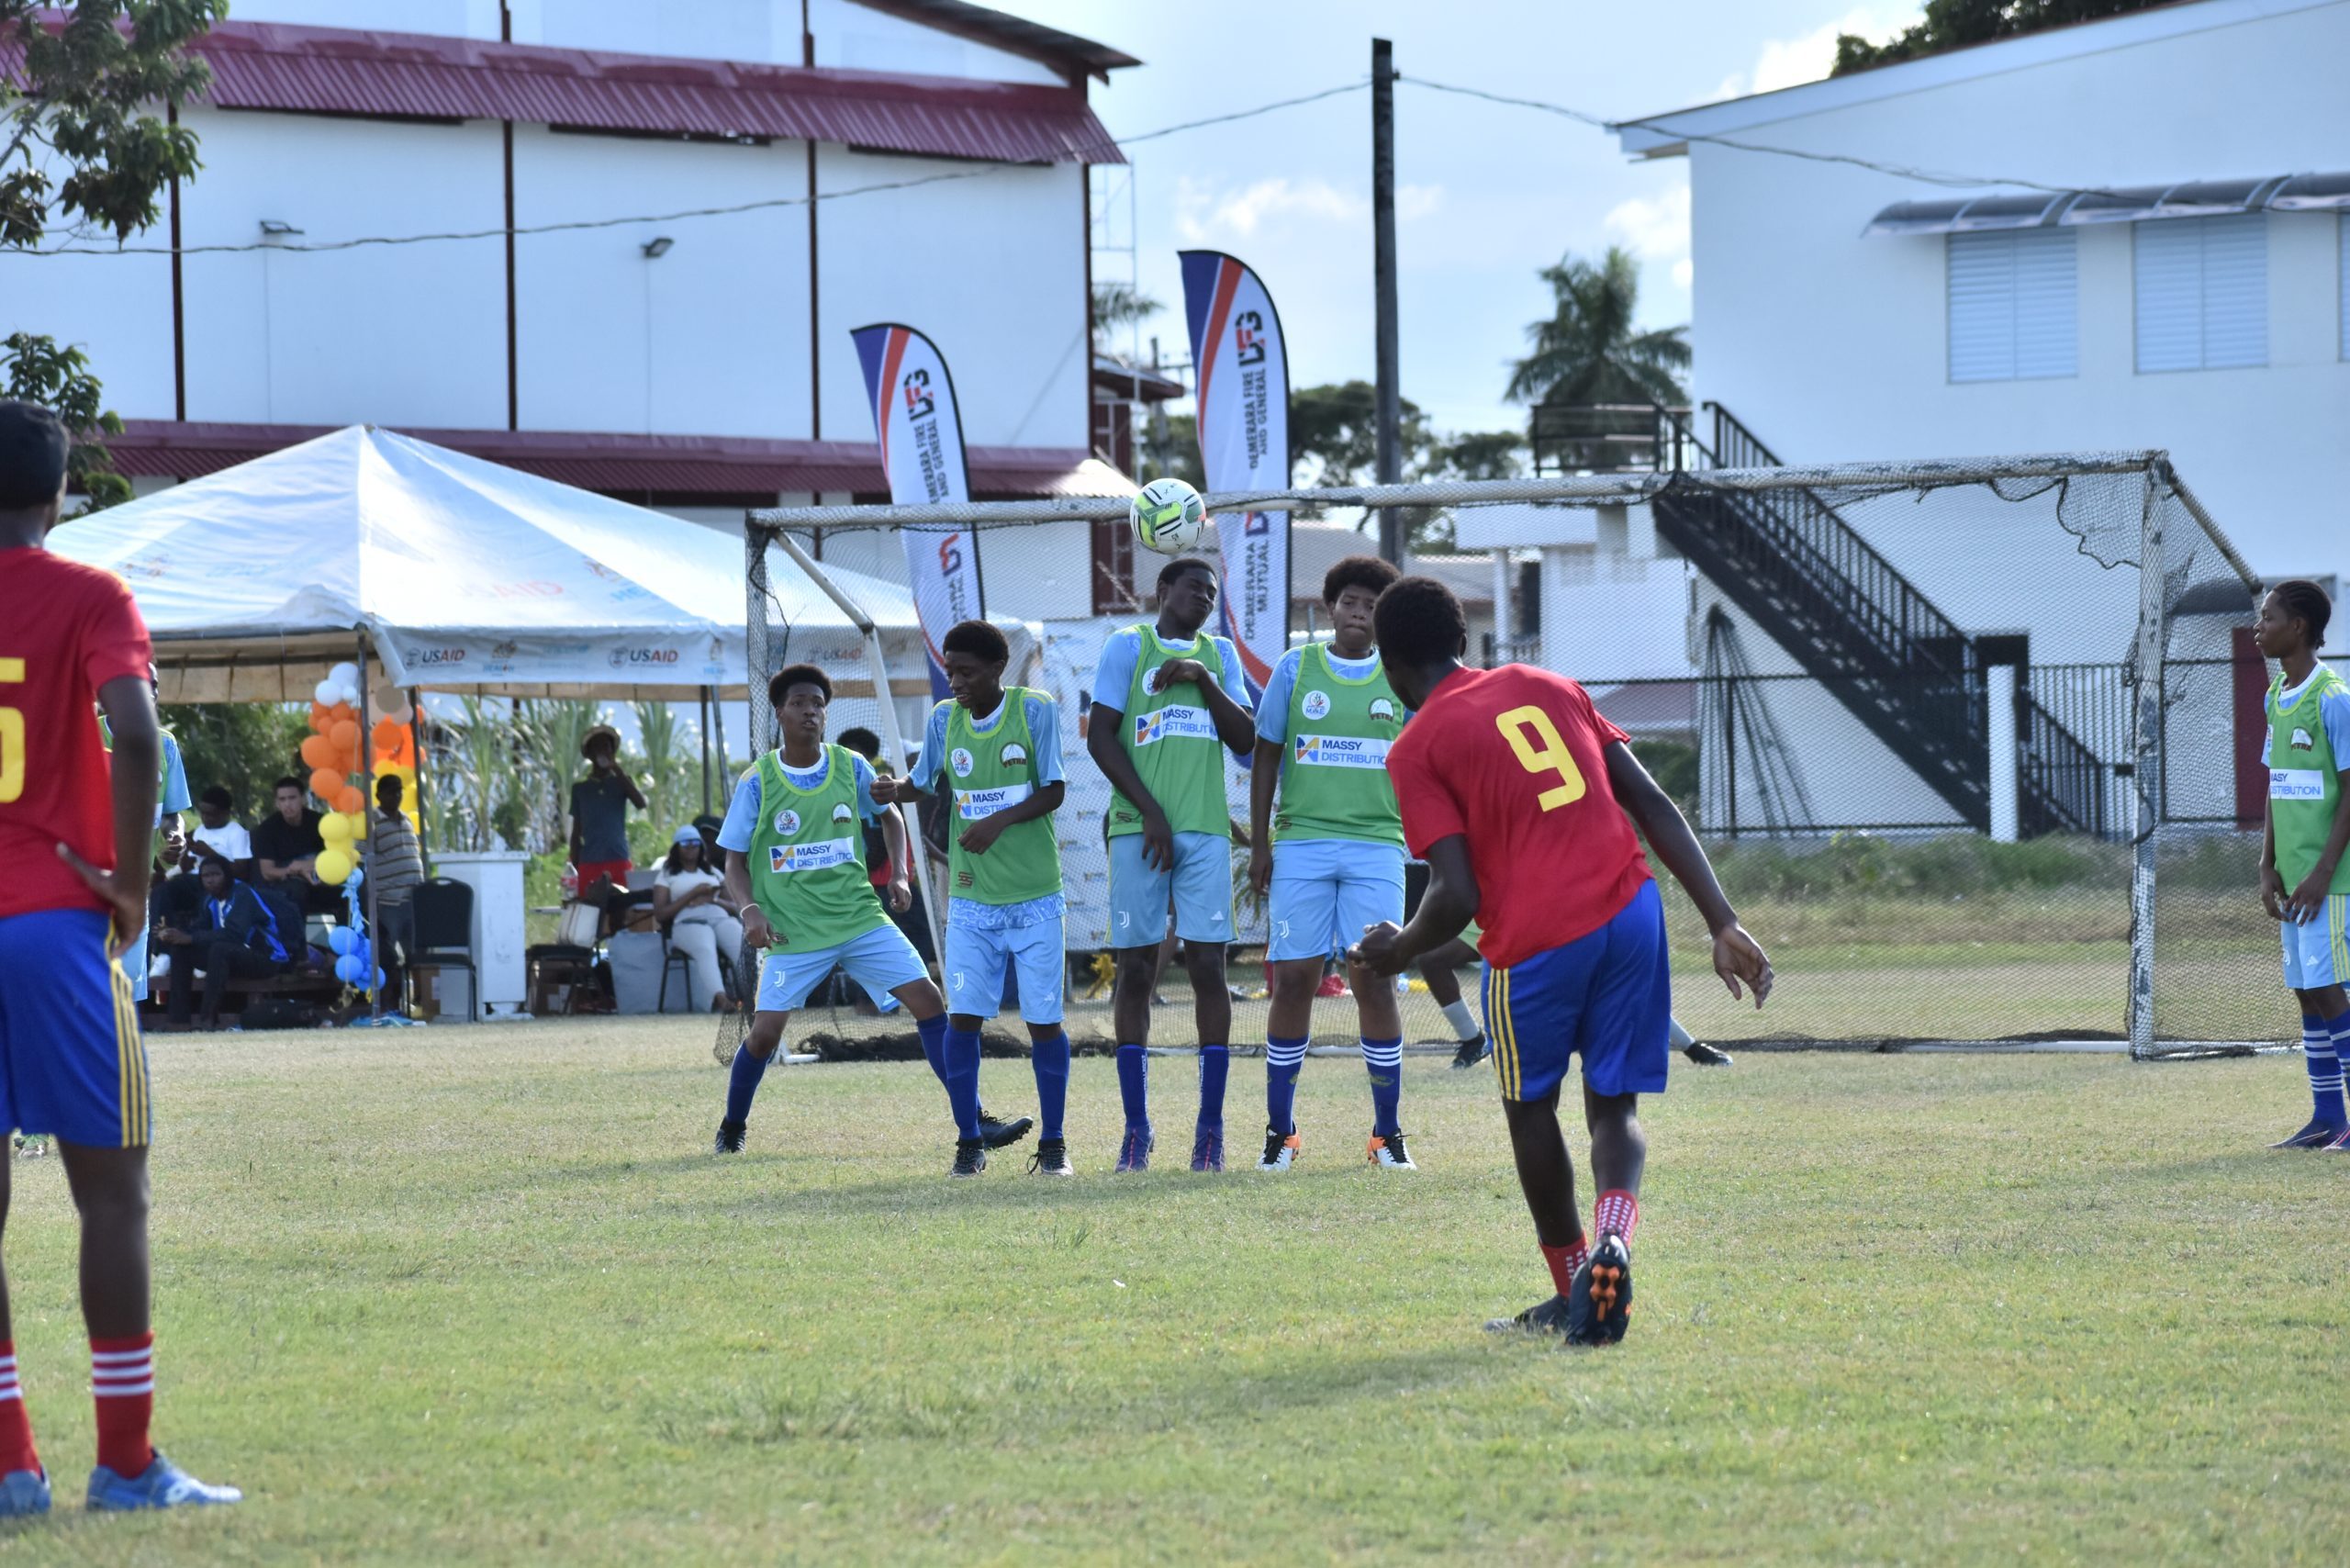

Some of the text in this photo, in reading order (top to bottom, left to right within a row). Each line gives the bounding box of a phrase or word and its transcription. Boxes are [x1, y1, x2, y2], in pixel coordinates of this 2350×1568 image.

[1242, 371, 1259, 469] DEMERARA FIRE
[1255, 368, 1268, 455] AND GENERAL
[913, 423, 941, 504] EMERARA FIRE
[927, 419, 949, 497] AND GENERAL
[1258, 540, 1269, 612] MUTUAL
[422, 649, 465, 663] USAID
[630, 649, 678, 662] USAID
[1321, 752, 1386, 766] DISTRIBUTIO
[1322, 739, 1363, 751] MASSY
[1495, 705, 1586, 812] 9
[972, 790, 1006, 803] MASSY
[796, 845, 832, 857] MASSY
